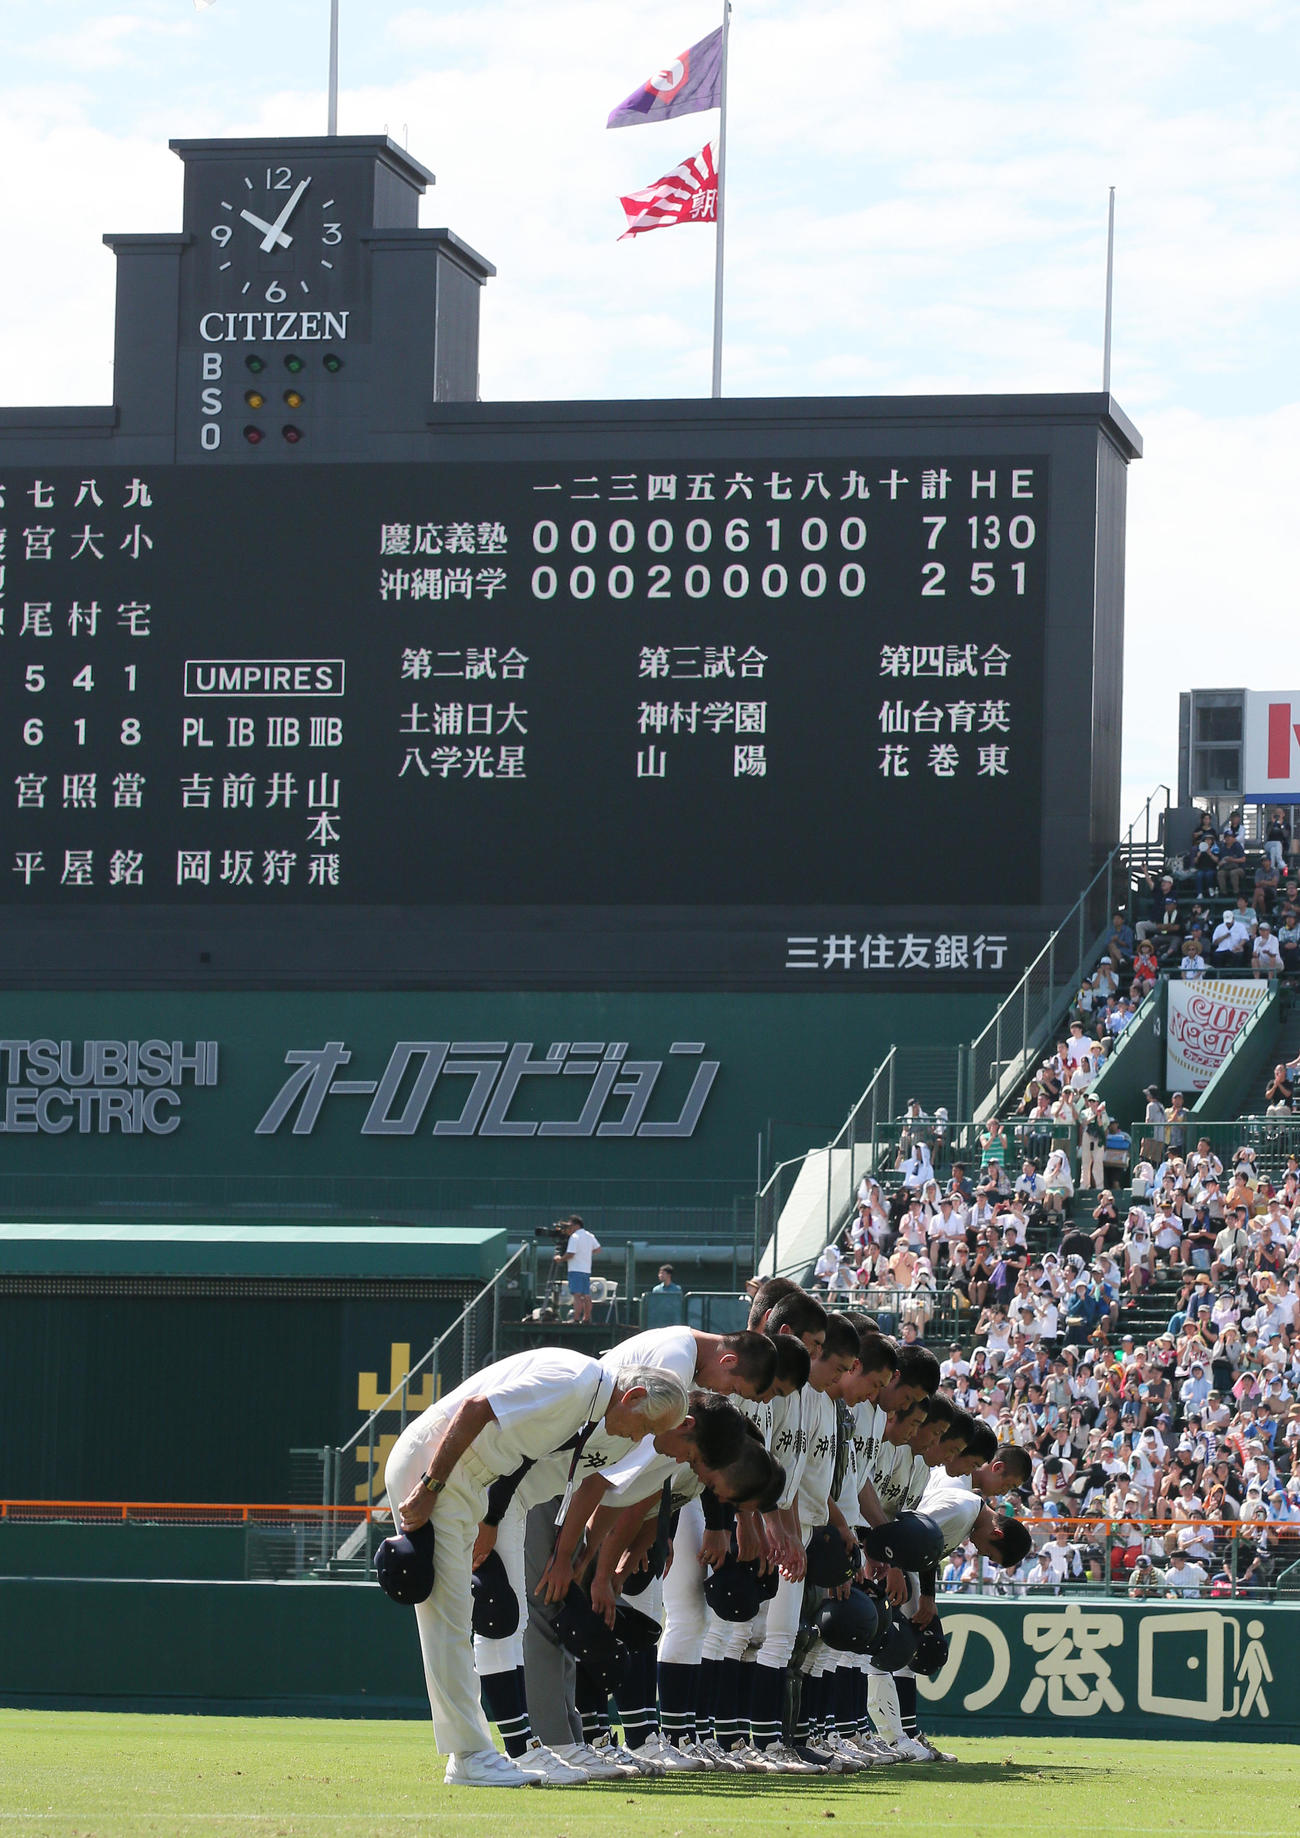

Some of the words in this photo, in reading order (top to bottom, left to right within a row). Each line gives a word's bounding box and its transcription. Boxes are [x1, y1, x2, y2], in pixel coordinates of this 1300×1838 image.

[267, 167, 291, 189] 12
[211, 225, 232, 247] 9
[322, 223, 342, 244] 3
[265, 281, 286, 303] 6
[200, 311, 350, 342] CITIZEN
[203, 353, 222, 380] B
[202, 388, 222, 415] S
[27, 480, 54, 507] 七
[75, 479, 103, 507] 八
[123, 478, 152, 508] 九
[571, 477, 600, 498] 二
[609, 474, 638, 500] 三
[648, 474, 677, 501] 四
[686, 473, 715, 500] 五
[725, 472, 754, 500] 六
[764, 472, 792, 499] 七
[801, 472, 831, 500] 八
[840, 470, 870, 500] 九
[879, 469, 909, 499] 十
[922, 469, 952, 499] 計
[972, 470, 996, 498] H
[1012, 470, 1033, 498] E
[380, 522, 507, 555] 慶応義塾
[533, 520, 558, 553] 0
[571, 520, 596, 553] 0
[609, 519, 635, 553] 0
[648, 519, 673, 552] 0
[686, 519, 711, 552] 0
[725, 518, 749, 552] 6
[766, 518, 780, 551] 1
[802, 517, 828, 551] 0
[841, 517, 866, 550] 0
[923, 516, 946, 549] 7
[968, 515, 1000, 549] 13
[1009, 515, 1035, 549] 0
[380, 568, 506, 600] 沖縄尚学
[532, 566, 557, 599] 0
[570, 566, 595, 599] 0
[608, 565, 634, 599] 0
[648, 565, 671, 598] 2
[685, 565, 710, 598] 0
[723, 564, 749, 598] 0
[762, 564, 788, 597] 0
[800, 563, 826, 597] 0
[839, 563, 865, 597] 0
[922, 562, 945, 595] 2
[970, 562, 995, 595] 5
[1012, 562, 1025, 594] 1
[401, 647, 529, 679] 第二試合
[639, 646, 768, 678] 第三試合
[880, 644, 1011, 677] 第四試合
[25, 665, 45, 692] 5
[73, 665, 94, 691] 4
[125, 665, 136, 691] 1
[197, 667, 332, 690] UMPIRES
[24, 718, 43, 745] 6
[75, 719, 85, 745] 1
[121, 718, 141, 745] 8
[183, 718, 213, 746] PL
[400, 702, 528, 735] 土浦日大
[638, 701, 767, 733] 神村学園
[879, 700, 1010, 733] 仙台育英
[398, 746, 526, 778] 八学光星
[878, 744, 1009, 776] 花巻東
[786, 934, 1007, 969] 三井住友銀行
[254, 1041, 721, 1138] オーロラビジョン
[0, 1087, 182, 1135] ECTRIC
